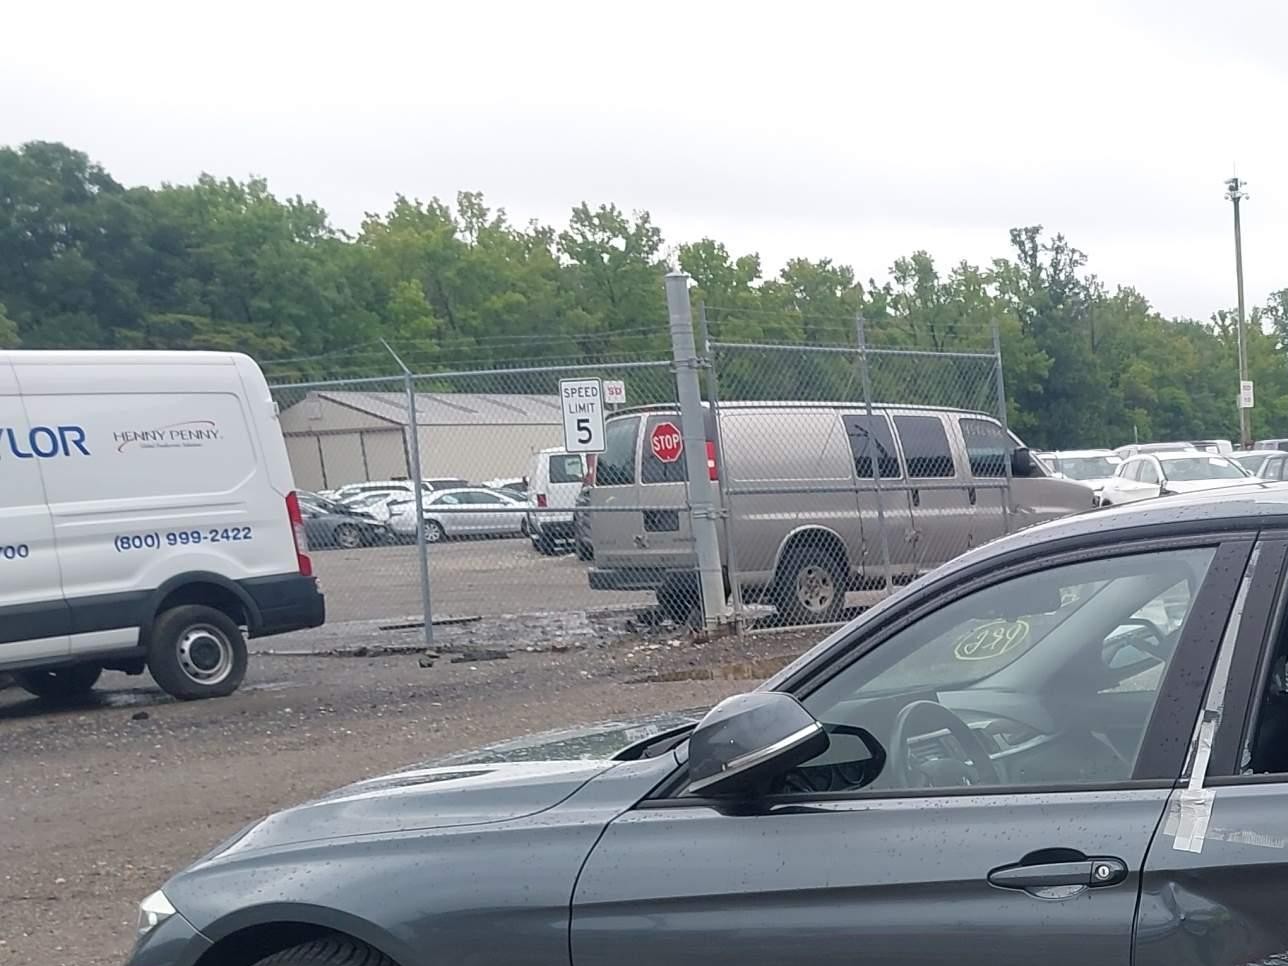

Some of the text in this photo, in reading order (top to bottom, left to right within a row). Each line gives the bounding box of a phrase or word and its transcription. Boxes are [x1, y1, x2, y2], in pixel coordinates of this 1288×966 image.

[564, 386, 598, 398] SPEED
[569, 403, 595, 414] LIMIT
[112, 429, 219, 441] HENNY PENNY
[577, 418, 592, 444] 5
[0, 426, 91, 458] LOR
[653, 435, 679, 451] STOP
[114, 526, 252, 552] (800) 999-2422
